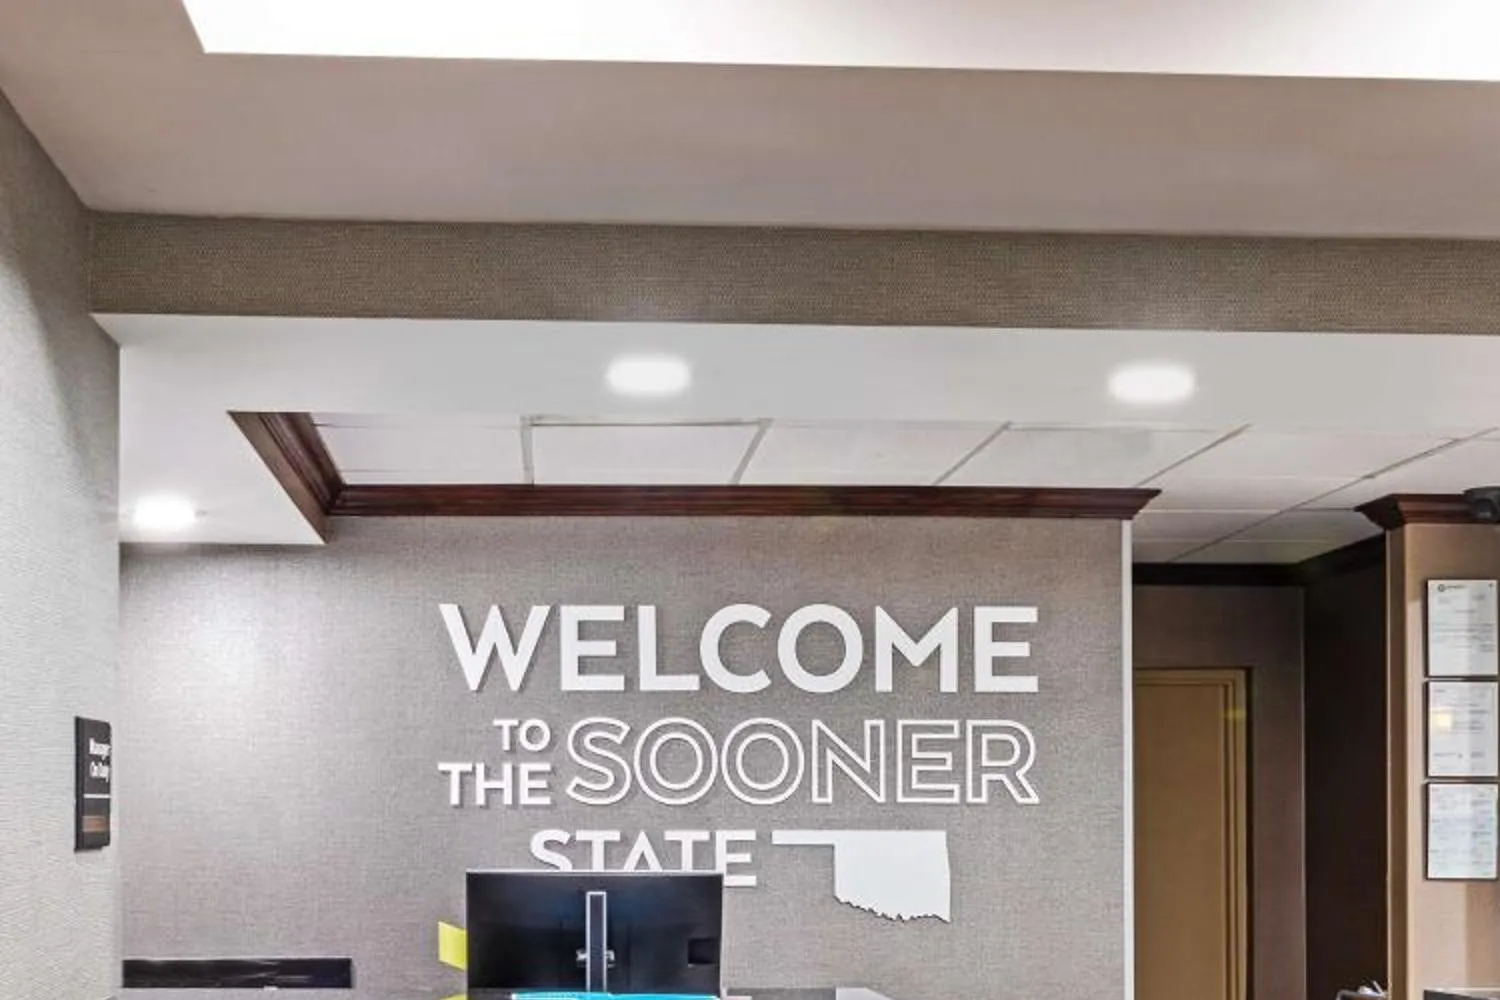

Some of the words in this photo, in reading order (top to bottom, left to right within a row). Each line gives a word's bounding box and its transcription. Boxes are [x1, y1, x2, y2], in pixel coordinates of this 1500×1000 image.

[438, 603, 1040, 693] WELCOME
[493, 718, 551, 752] TO
[566, 716, 1040, 805] SOONER
[438, 762, 552, 806] THE
[530, 829, 757, 887] STATE
